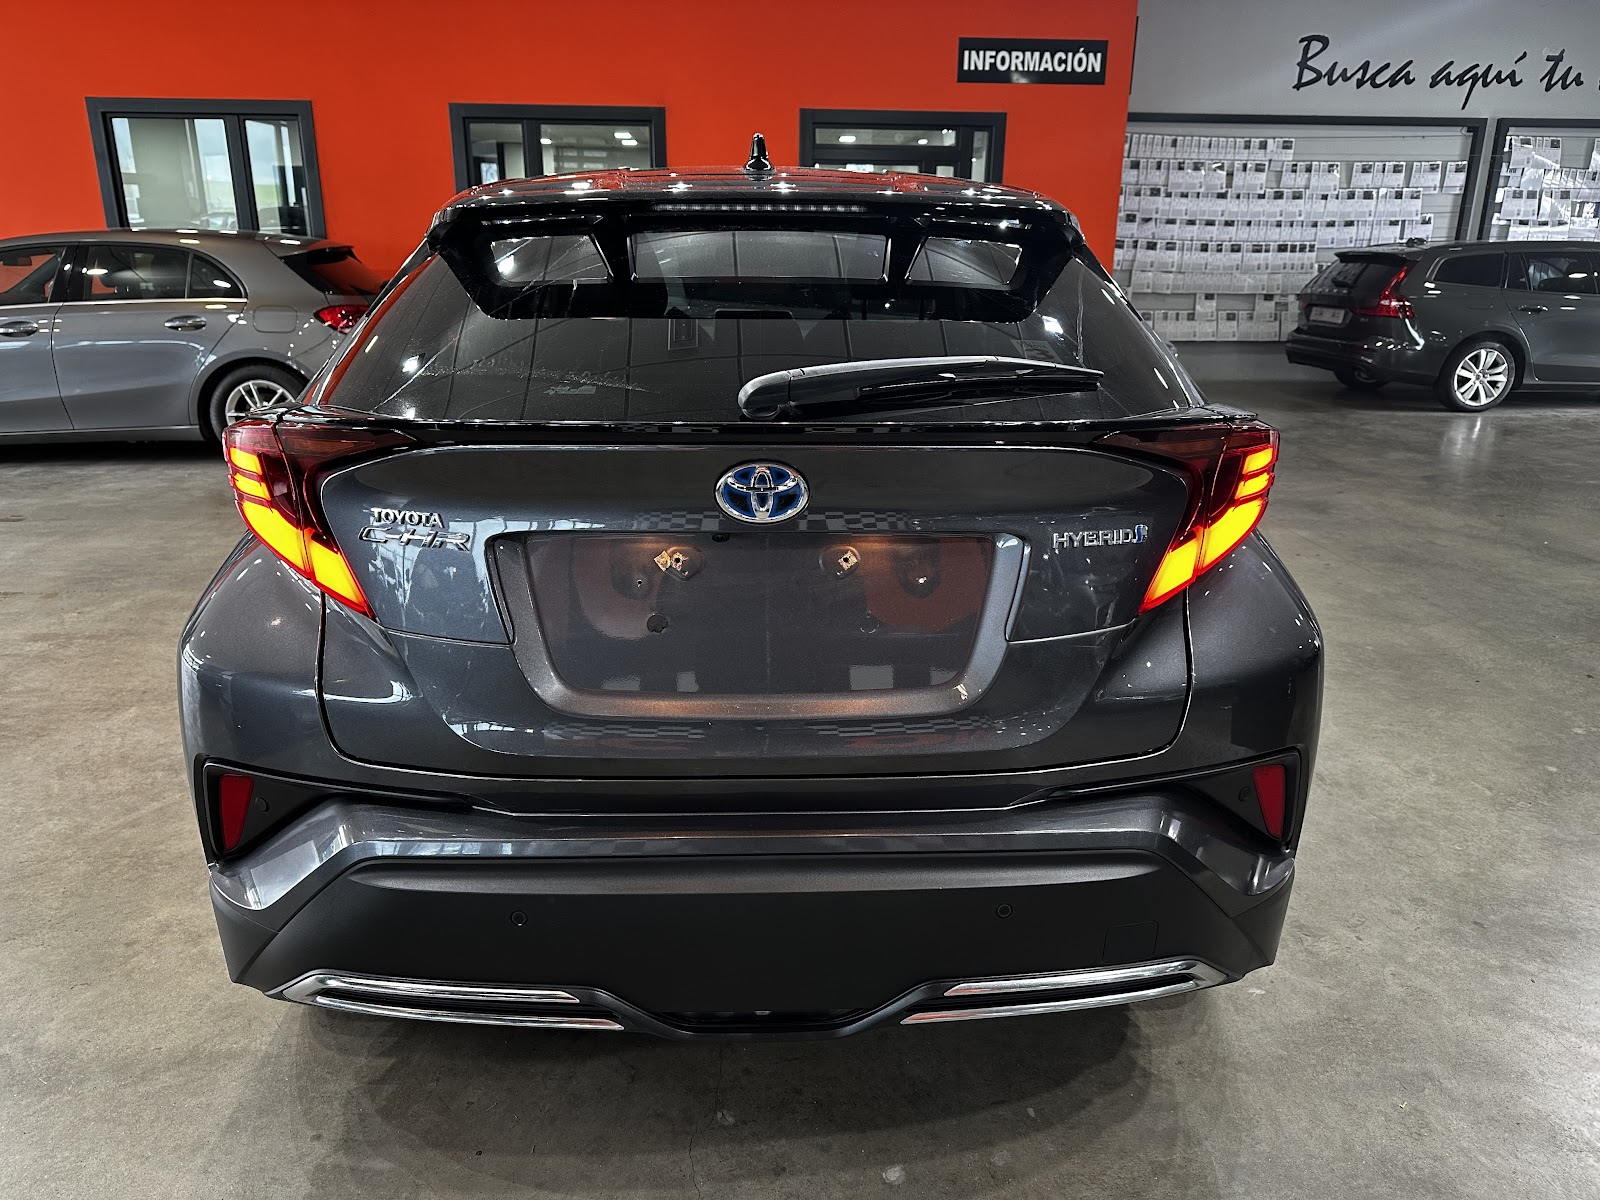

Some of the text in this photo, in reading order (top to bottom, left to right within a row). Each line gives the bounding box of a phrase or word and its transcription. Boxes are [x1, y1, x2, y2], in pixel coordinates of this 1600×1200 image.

[962, 47, 1102, 73] INFORMACIÓN
[1292, 34, 1584, 110] Busca aquí tu
[370, 507, 445, 529] TOYOTA
[358, 525, 471, 552] C-HR
[1052, 529, 1134, 549] HYBRID
